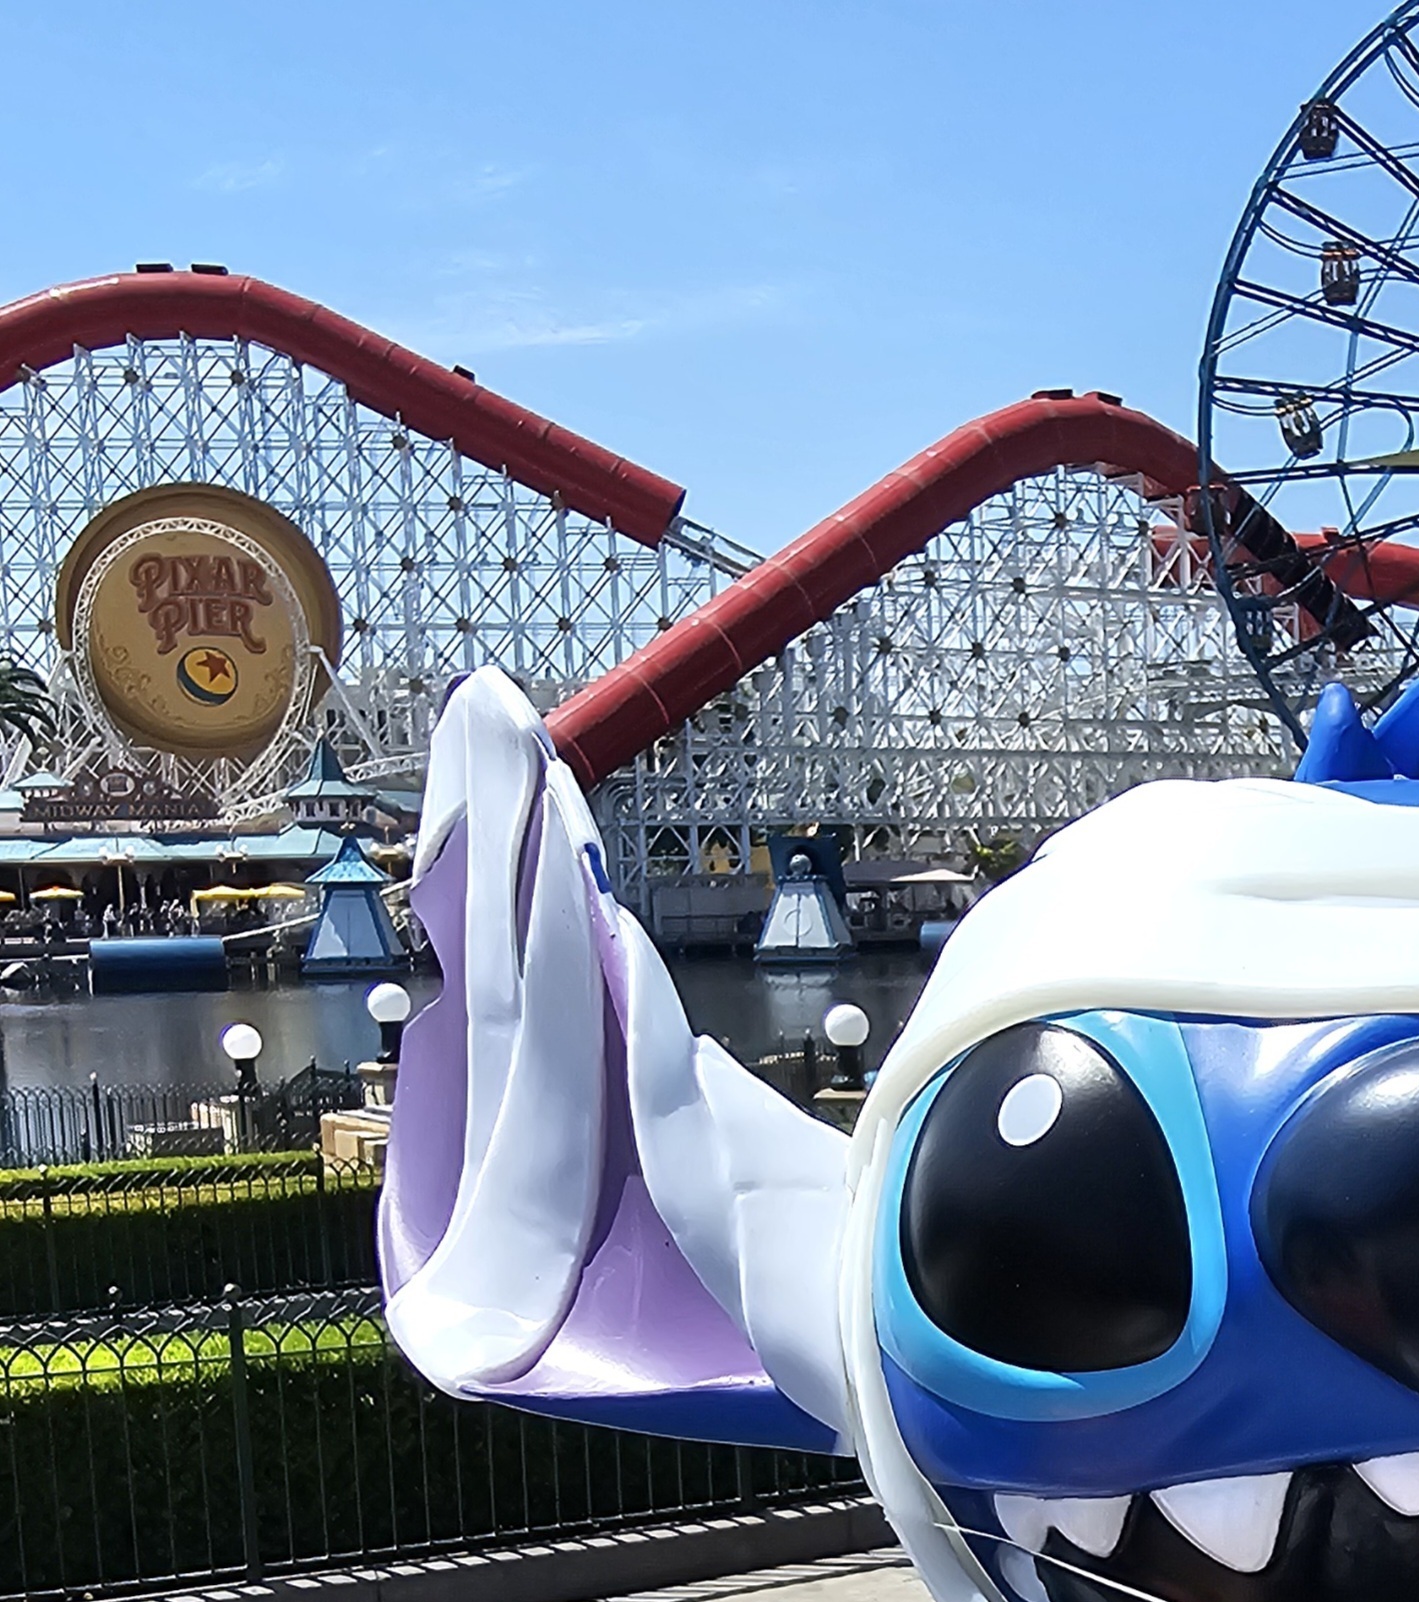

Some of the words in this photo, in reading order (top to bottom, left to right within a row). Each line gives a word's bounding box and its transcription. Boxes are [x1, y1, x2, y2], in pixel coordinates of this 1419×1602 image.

[129, 552, 273, 612] PIXAR
[148, 596, 267, 655] PIER
[33, 803, 121, 819] MIDWAY
[128, 802, 201, 817] MANIA
